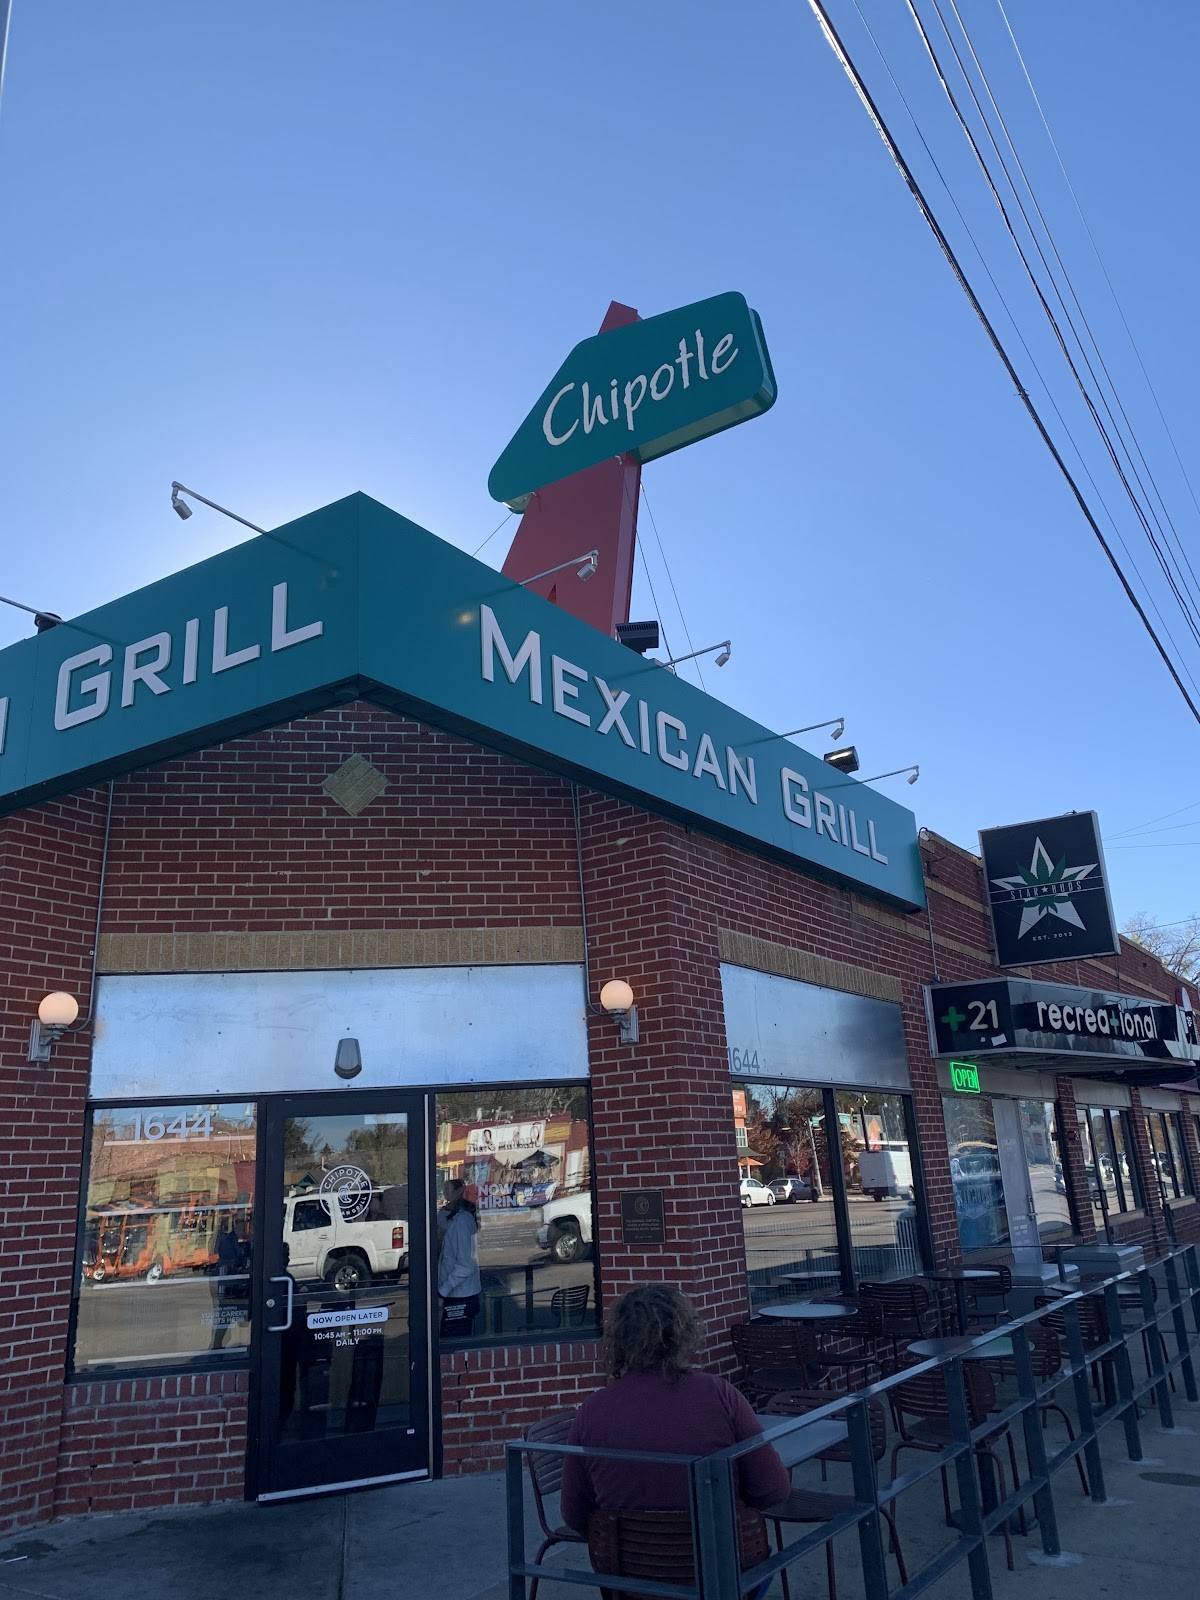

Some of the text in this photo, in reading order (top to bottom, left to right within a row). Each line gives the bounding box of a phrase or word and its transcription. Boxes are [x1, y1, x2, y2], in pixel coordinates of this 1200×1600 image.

[542, 328, 739, 446] Chipotle
[54, 581, 324, 731] GRILL
[480, 603, 889, 866] MEXICAN GRILL
[1010, 881, 1082, 900] STAR BUDS
[1032, 934, 1051, 942] EST.
[727, 1046, 761, 1074] 1644
[955, 1068, 979, 1089] OPEN
[131, 1110, 214, 1142] 1644
[323, 1168, 368, 1189] CHIPOTLE
[478, 1183, 514, 1196] NOW
[220, 1310, 249, 1319] CAREER
[312, 1311, 383, 1325] NOW OPEN LATER
[314, 1331, 335, 1341] 10:45
[353, 1328, 372, 1337] 11:00
[335, 1337, 360, 1347] DAILY
